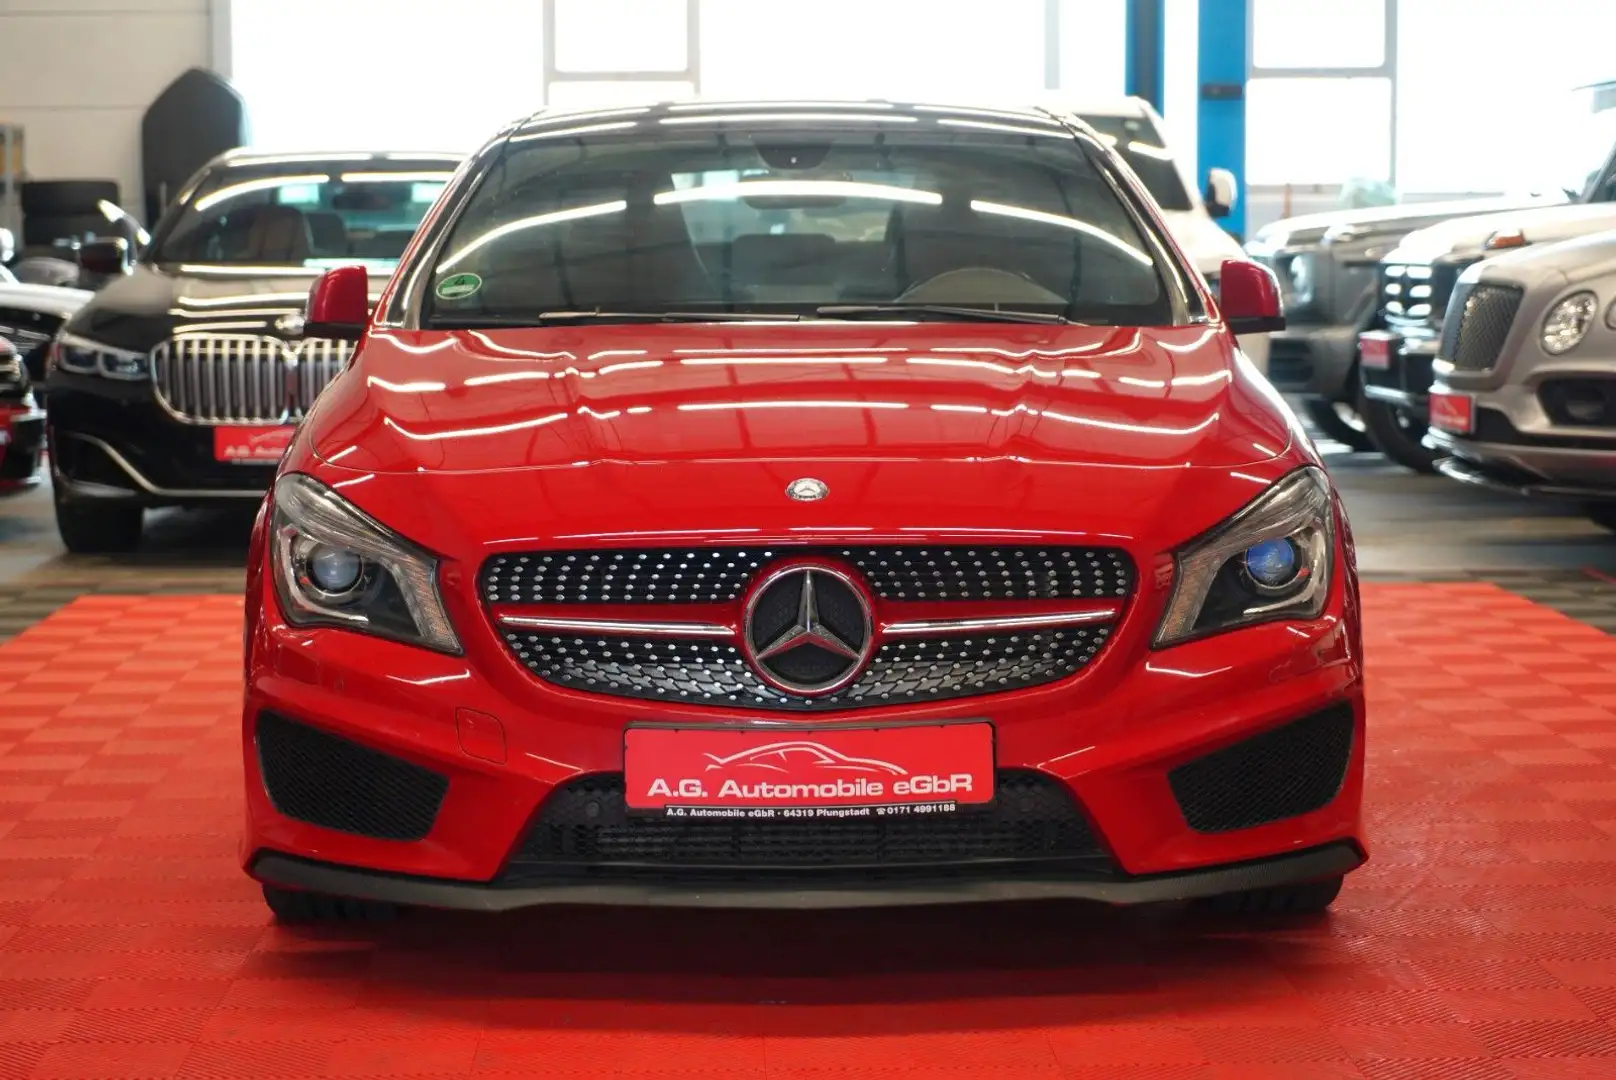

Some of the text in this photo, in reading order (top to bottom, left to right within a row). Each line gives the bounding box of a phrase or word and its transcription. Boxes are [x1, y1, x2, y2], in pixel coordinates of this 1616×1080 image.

[647, 774, 973, 798] A.G. Automobile eGbR
[667, 803, 956, 818] A.G. Automobile eGbR 64319 Pfungstadt 0171 4991188
